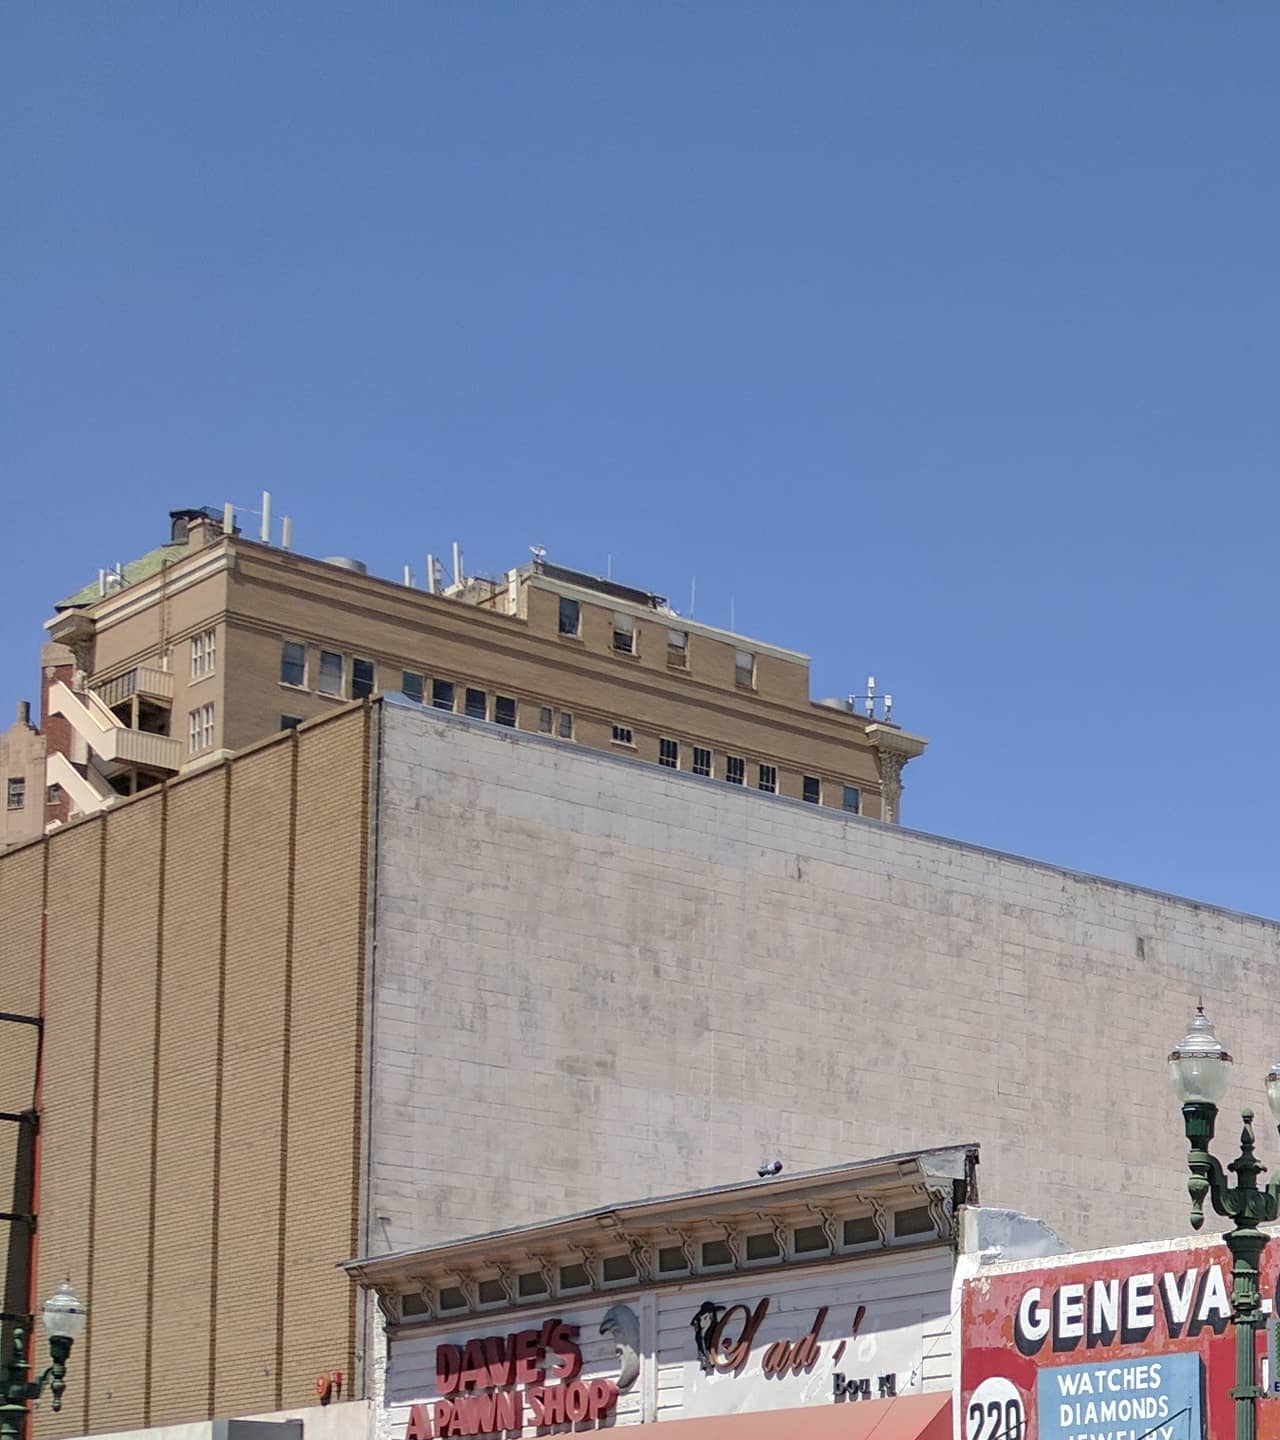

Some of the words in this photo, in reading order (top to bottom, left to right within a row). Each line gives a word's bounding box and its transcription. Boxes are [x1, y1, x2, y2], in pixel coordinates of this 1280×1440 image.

[1018, 1264, 1232, 1343] GENEVA
[435, 1318, 583, 1394] DAVE'S
[1057, 1363, 1162, 1397] WATCHES
[406, 1404, 433, 1440] A
[433, 1391, 524, 1438] PAWN
[525, 1379, 621, 1427] SHOP
[1059, 1395, 1169, 1428] DIAMONDS
